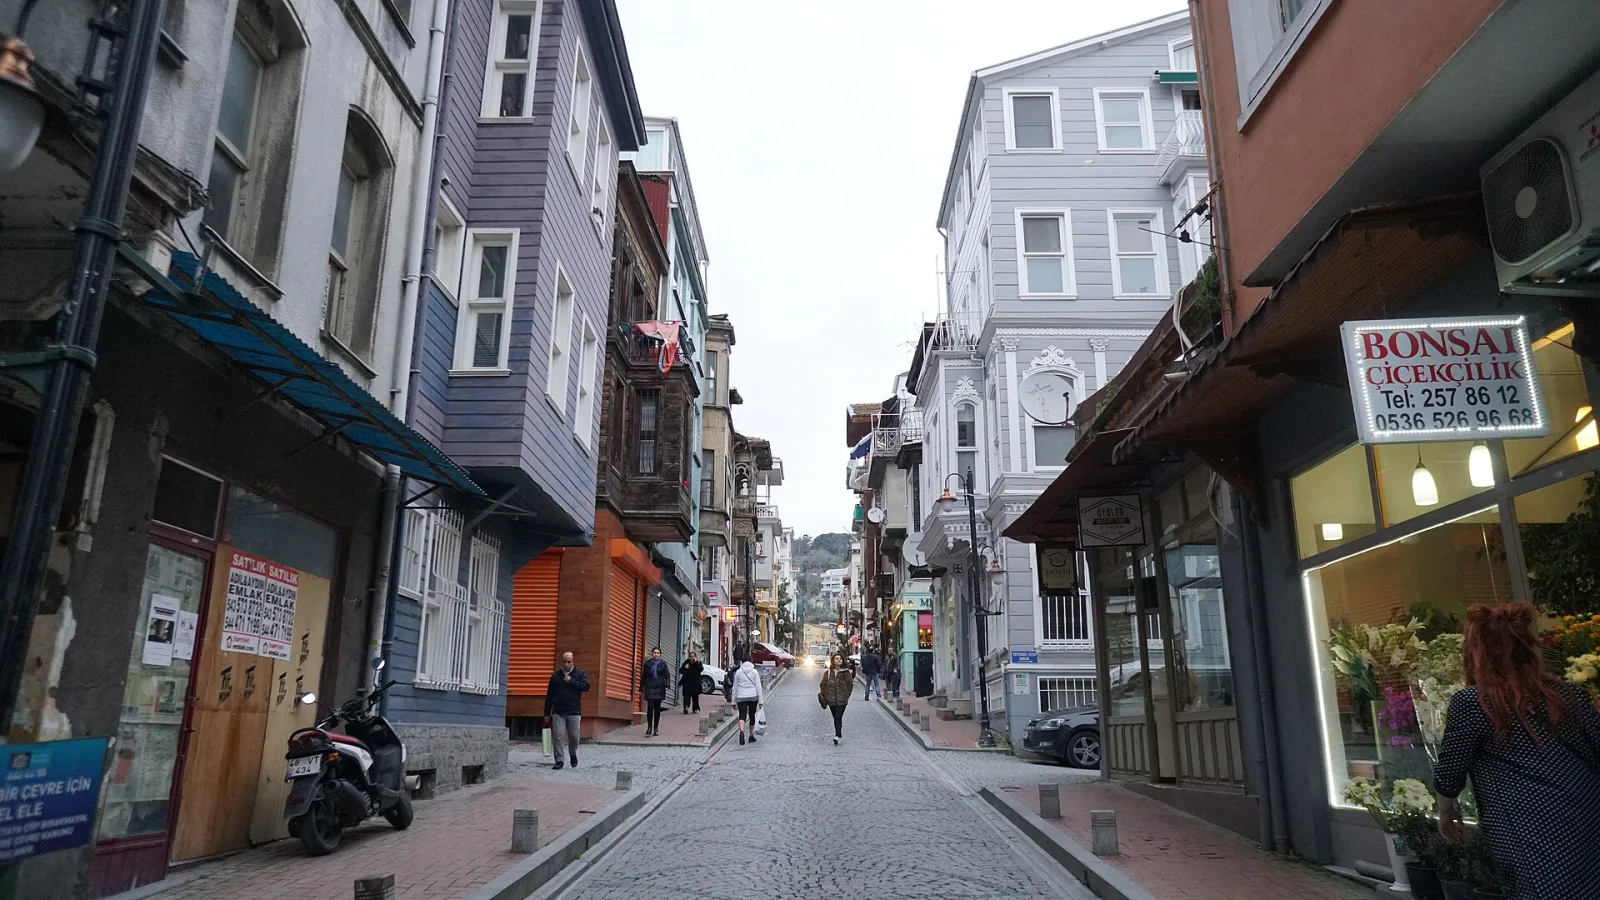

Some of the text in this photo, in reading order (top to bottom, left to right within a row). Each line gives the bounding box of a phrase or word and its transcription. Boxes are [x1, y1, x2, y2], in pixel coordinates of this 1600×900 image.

[1360, 327, 1519, 360] BONSAI
[1365, 356, 1524, 390] ÇİÇEKÇİLİK
[1381, 385, 1520, 409] Tel: 257 86 12
[1375, 408, 1533, 431] 0536 526 96 68
[232, 553, 267, 574] SATILIK
[268, 565, 299, 585] SATILIK
[228, 584, 263, 601] EMLAK
[266, 593, 295, 610] EMLAK
[290, 756, 320, 767] 48 VT
[295, 766, 312, 774] 434
[21, 780, 65, 799] ÇEVRE
[66, 775, 92, 794] İÇİN
[17, 802, 45, 819] ELE
